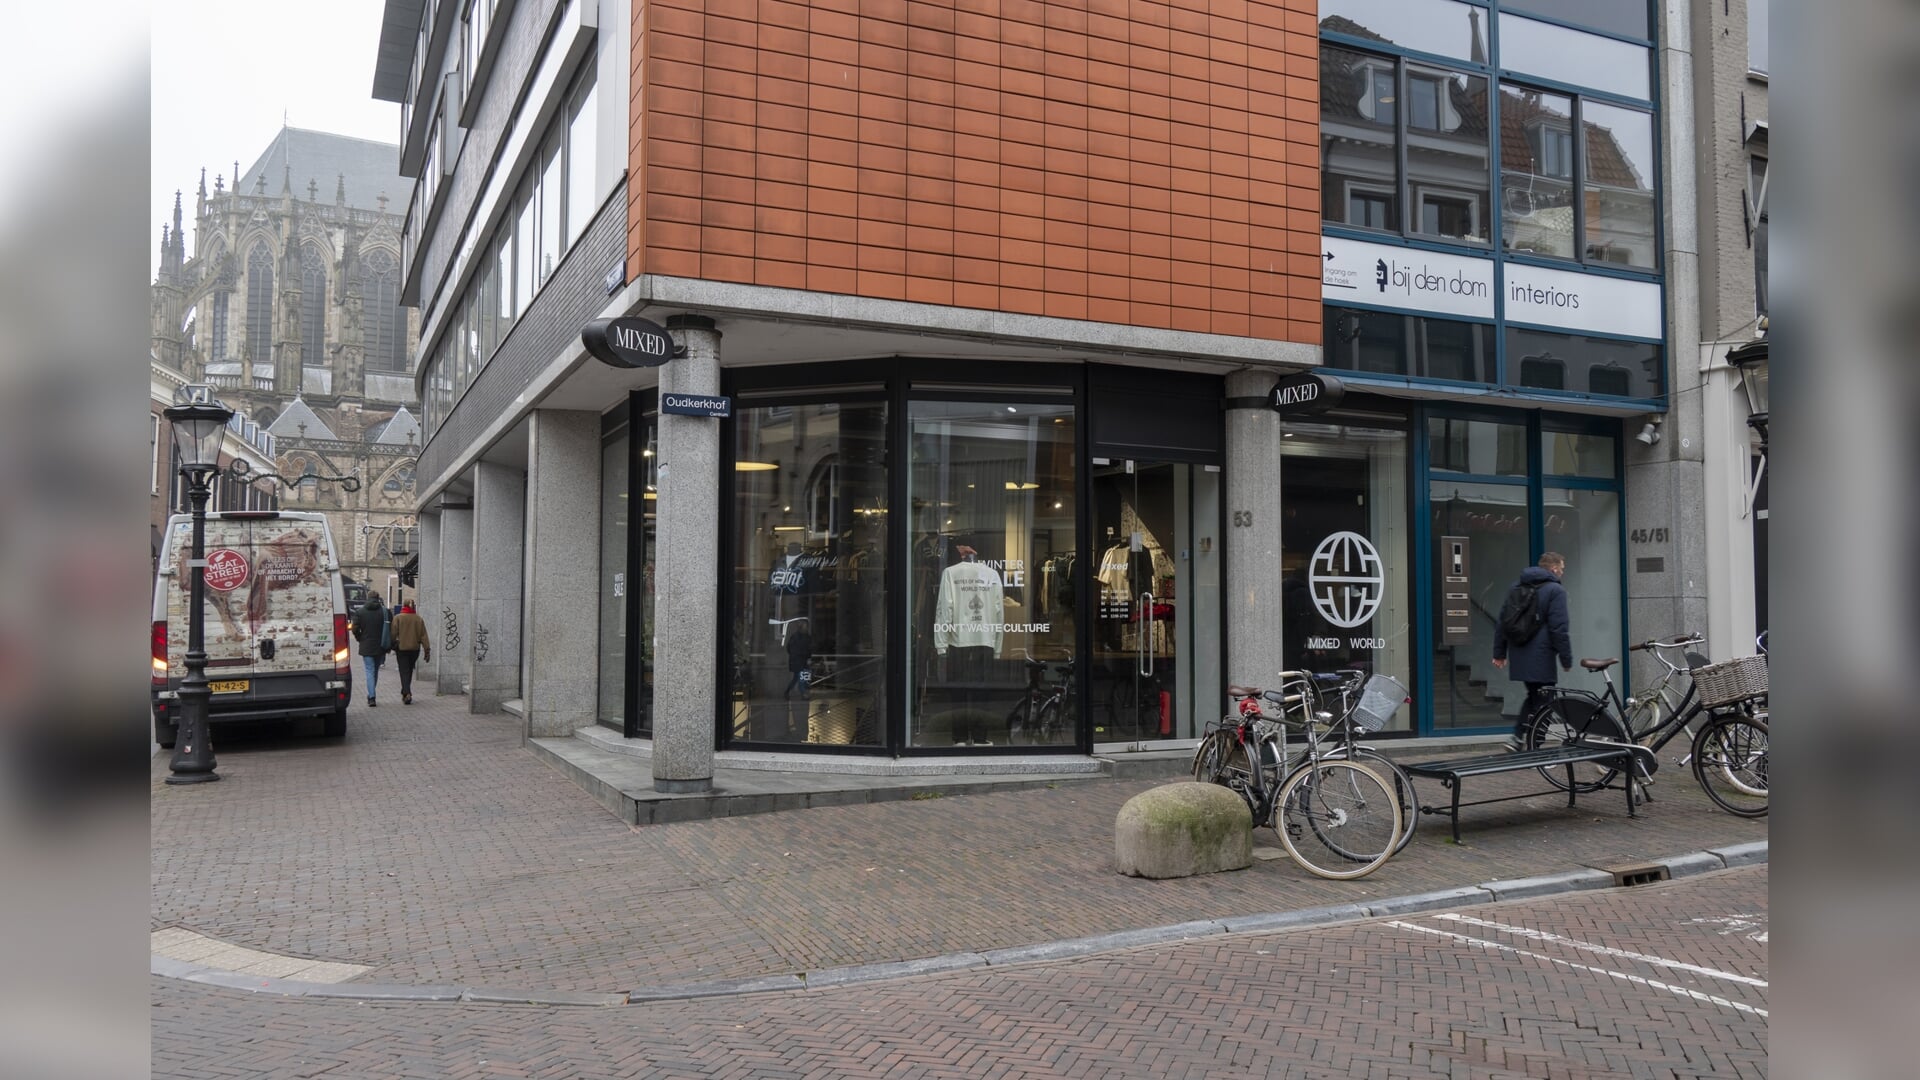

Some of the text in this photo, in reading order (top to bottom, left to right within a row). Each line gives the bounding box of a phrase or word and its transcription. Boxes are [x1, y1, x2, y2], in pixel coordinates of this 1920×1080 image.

[1325, 275, 1350, 284] de hoek
[1392, 259, 1579, 309] bij den dom interiors
[615, 325, 666, 357] MIXED
[1275, 382, 1318, 406] MIXED
[666, 396, 727, 411] Oudkerkhof
[1233, 510, 1253, 528] 53
[1630, 527, 1670, 544] 45/51
[208, 558, 238, 573] MEAT
[977, 559, 1025, 570] WINTER
[205, 564, 246, 581] STREET
[614, 582, 624, 597] SALE
[933, 623, 1050, 633] DON'T WASTE CULTURE
[1308, 637, 1386, 649] MIXED WORLD
